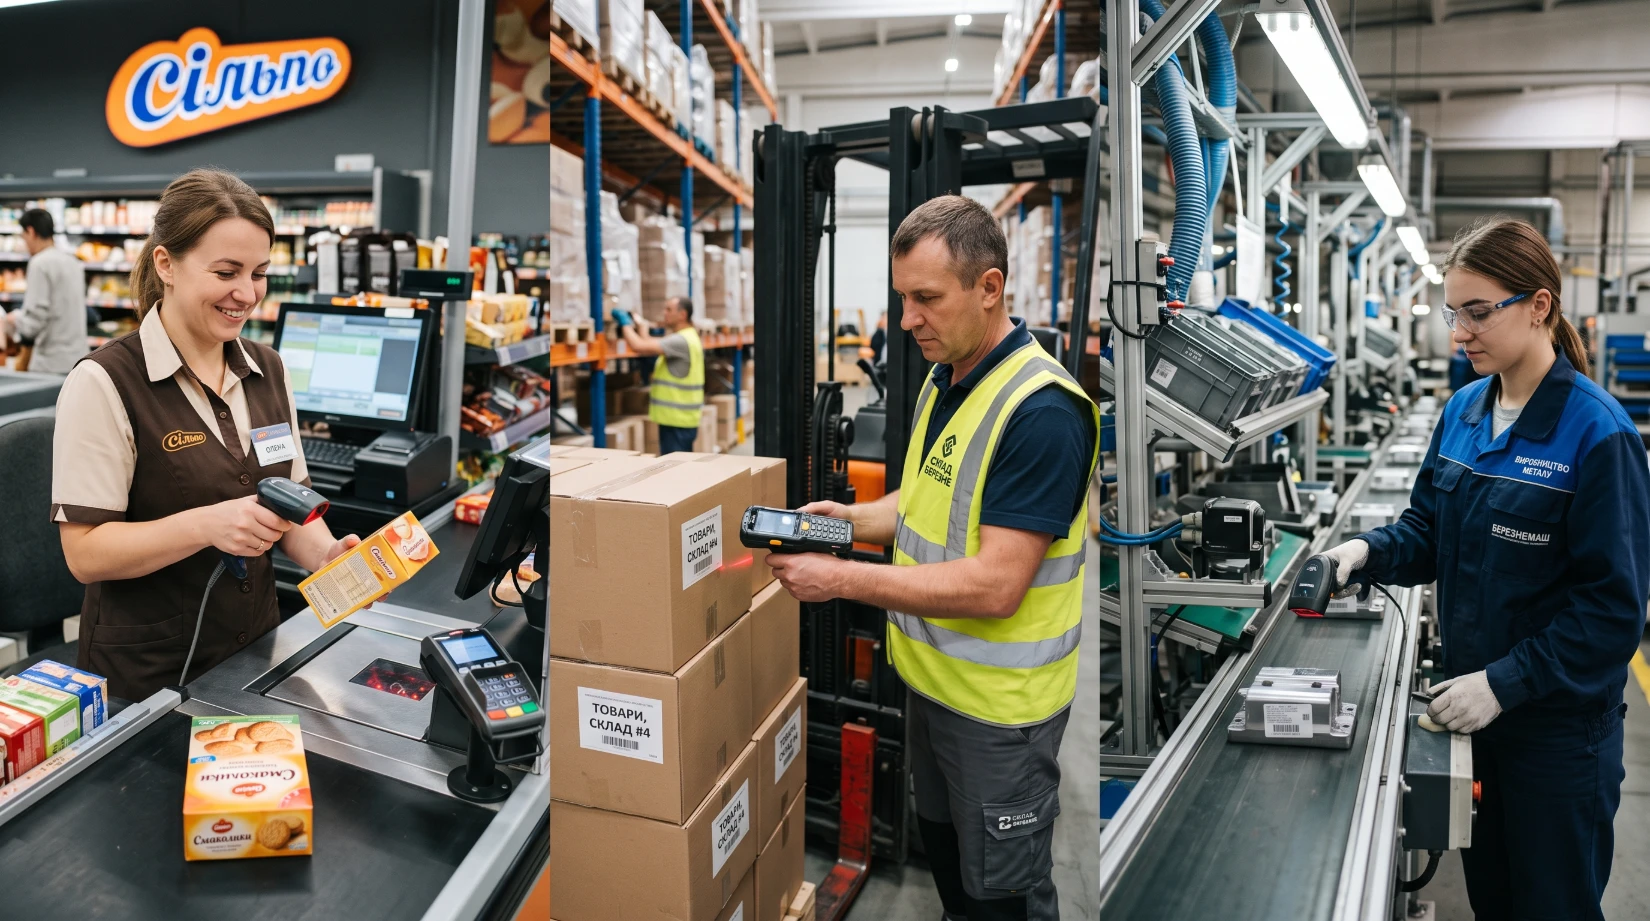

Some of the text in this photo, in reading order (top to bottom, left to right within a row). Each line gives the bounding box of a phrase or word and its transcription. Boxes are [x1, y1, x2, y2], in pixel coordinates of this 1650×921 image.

[130, 46, 336, 123] Сільпо
[168, 431, 204, 448] Сільпо
[1514, 455, 1570, 474] ВИРОБНИЦТВО
[1522, 466, 1553, 479] МЕТАЛУ
[688, 523, 716, 545] ТОВАРИ,
[1491, 523, 1551, 542] БЕРЕЗНЕМАШ
[687, 542, 710, 563] СКЛАД
[592, 702, 647, 724] ТОВАРИ,
[589, 718, 651, 739] СКЛАД #4
[200, 768, 296, 782] Смаколики
[193, 833, 252, 846] Смаколики
